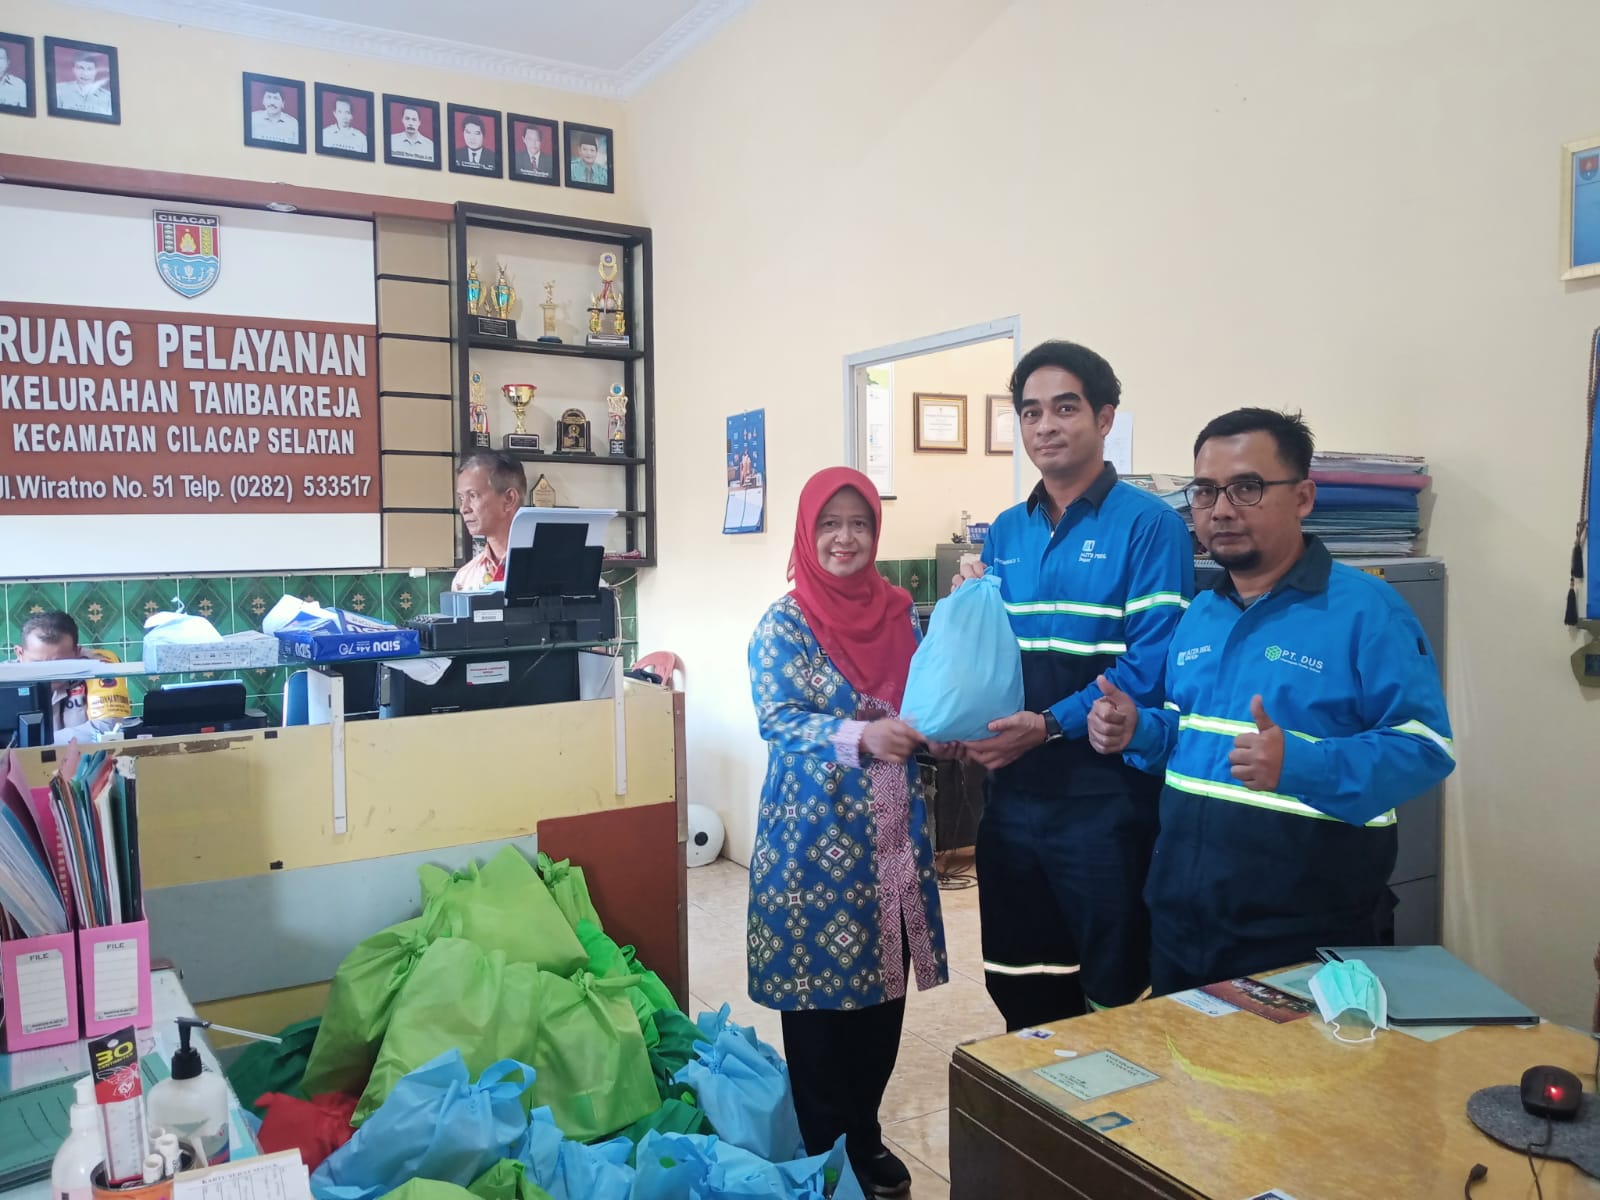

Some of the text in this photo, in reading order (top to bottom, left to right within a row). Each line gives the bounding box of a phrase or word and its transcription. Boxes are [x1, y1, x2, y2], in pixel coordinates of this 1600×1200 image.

[158, 214, 216, 225] CILACAP
[0, 315, 366, 377] RUANG PELAYANAN
[1, 375, 361, 418] KELURAHAN TAMBAKREJA
[13, 423, 354, 455] KECAMATAN CILACAP SELATAN
[16, 475, 106, 499] Wiratno
[112, 475, 147, 499] No.
[152, 475, 174, 498] 51
[180, 476, 224, 501] Telp.
[230, 475, 293, 503] (0282)
[303, 475, 371, 497] 533517
[1281, 649, 1297, 661] PT.
[1300, 655, 1323, 669] DUS
[29, 952, 49, 961] FILE
[106, 942, 125, 950] FILE
[95, 1041, 133, 1067] 30
